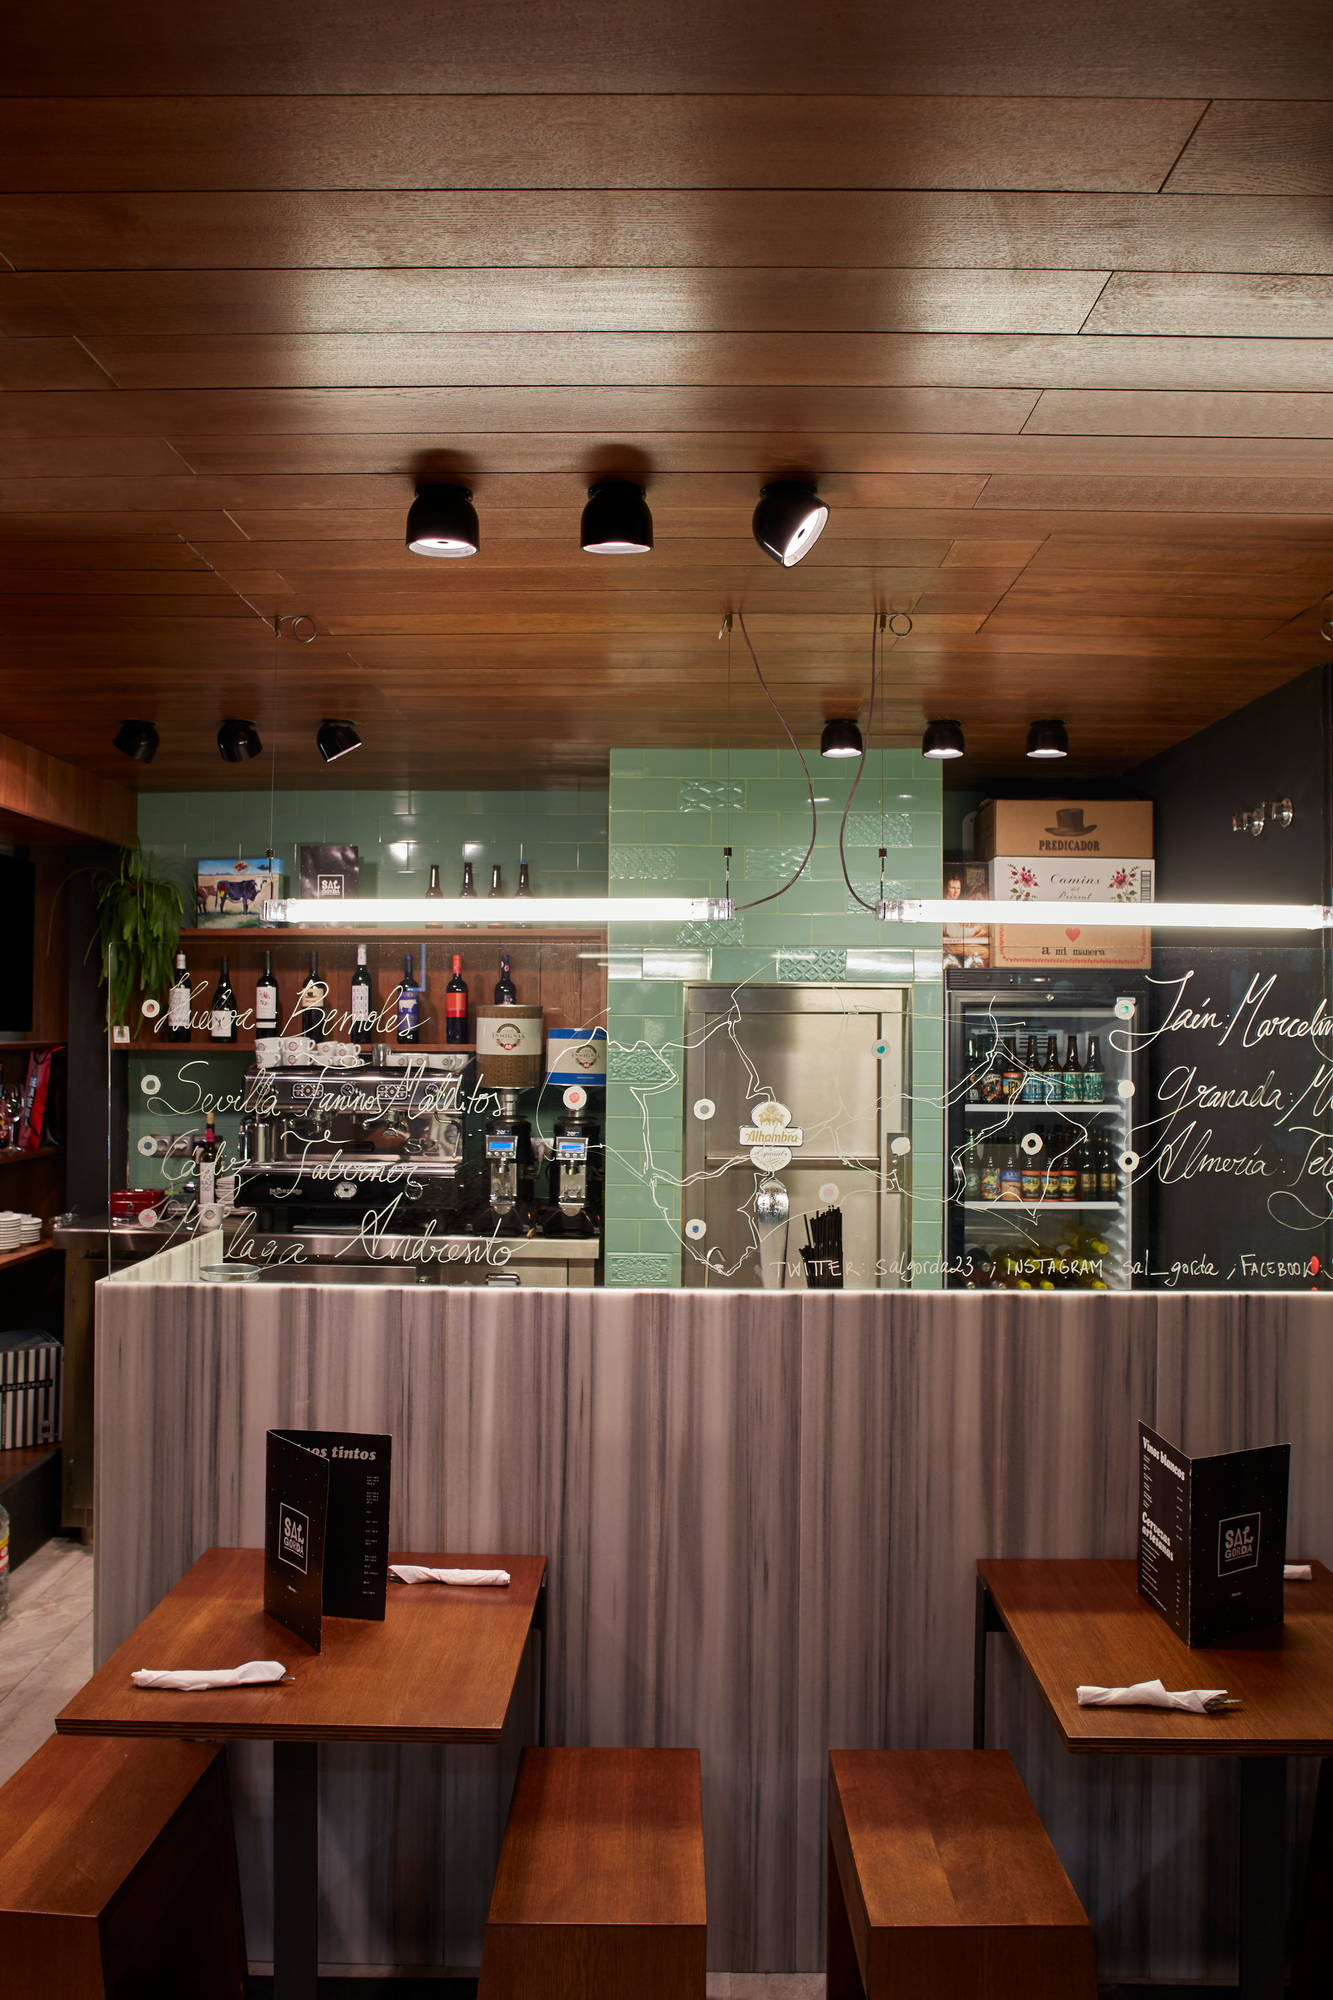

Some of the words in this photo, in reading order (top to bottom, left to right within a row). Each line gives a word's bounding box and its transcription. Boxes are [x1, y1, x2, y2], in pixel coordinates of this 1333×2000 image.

[1039, 840, 1100, 851] PREDICADOR
[1050, 873, 1100, 885] Camins
[1042, 946, 1050, 955] a
[1072, 948, 1106, 956] manera
[147, 1060, 281, 1116] Sevilla
[366, 1059, 507, 1122] Malditos
[745, 1130, 798, 1143] Alhambra
[335, 1192, 514, 1266] Andresito
[1, 1380, 51, 1392] SOSPECHOSO
[331, 1445, 377, 1461] tintos
[1142, 1436, 1160, 1460] Vinos
[1160, 1450, 1186, 1482] blancos
[284, 1517, 305, 1545] SAL
[1141, 1511, 1171, 1547] Cervezas
[1224, 1525, 1254, 1549] SAL
[1141, 1524, 1174, 1562] artesanas
[1224, 1544, 1253, 1559] GORDA
